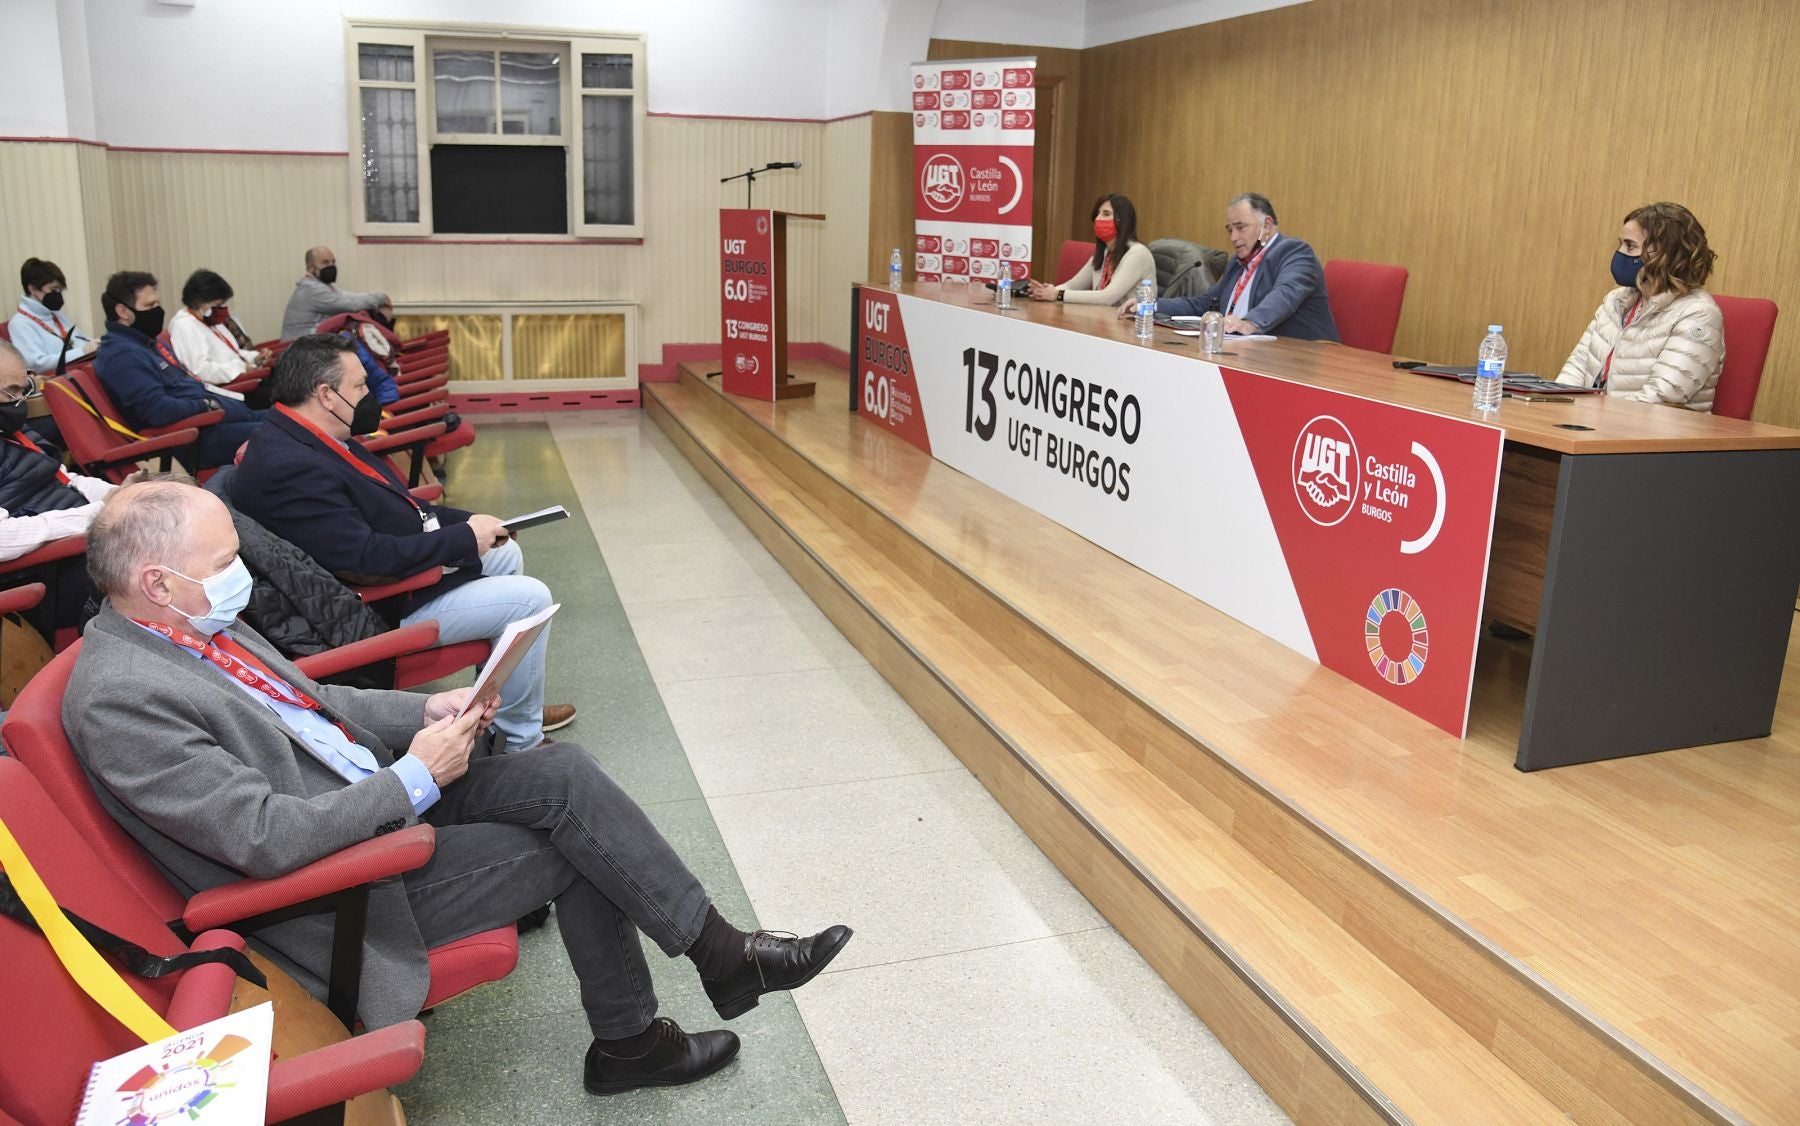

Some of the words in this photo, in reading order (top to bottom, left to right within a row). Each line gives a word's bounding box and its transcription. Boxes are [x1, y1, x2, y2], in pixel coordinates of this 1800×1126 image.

[927, 164, 959, 188] UGT
[969, 167, 1002, 180] Castilla
[969, 182, 976, 193] y
[977, 179, 998, 192] León
[724, 239, 747, 256] UGT
[724, 259, 768, 276] BURGOS
[724, 279, 748, 302] 6.0
[865, 299, 890, 334] UGT
[725, 319, 738, 339] 13
[737, 321, 769, 333] CONGRESO
[865, 337, 909, 375] BURGOS
[864, 370, 889, 419] 6.0
[963, 347, 999, 442] 13
[1004, 359, 1142, 445] CONGRESO
[1008, 417, 1043, 462] UGT
[1046, 432, 1131, 502] BURGOS
[1301, 432, 1351, 483] UGT
[1365, 455, 1416, 489] Castilla
[1363, 480, 1373, 501] y
[1375, 480, 1409, 509] León
[1361, 503, 1393, 523] BURGOS
[161, 1037, 205, 1060] 2021
[149, 1079, 200, 1102] unidos
